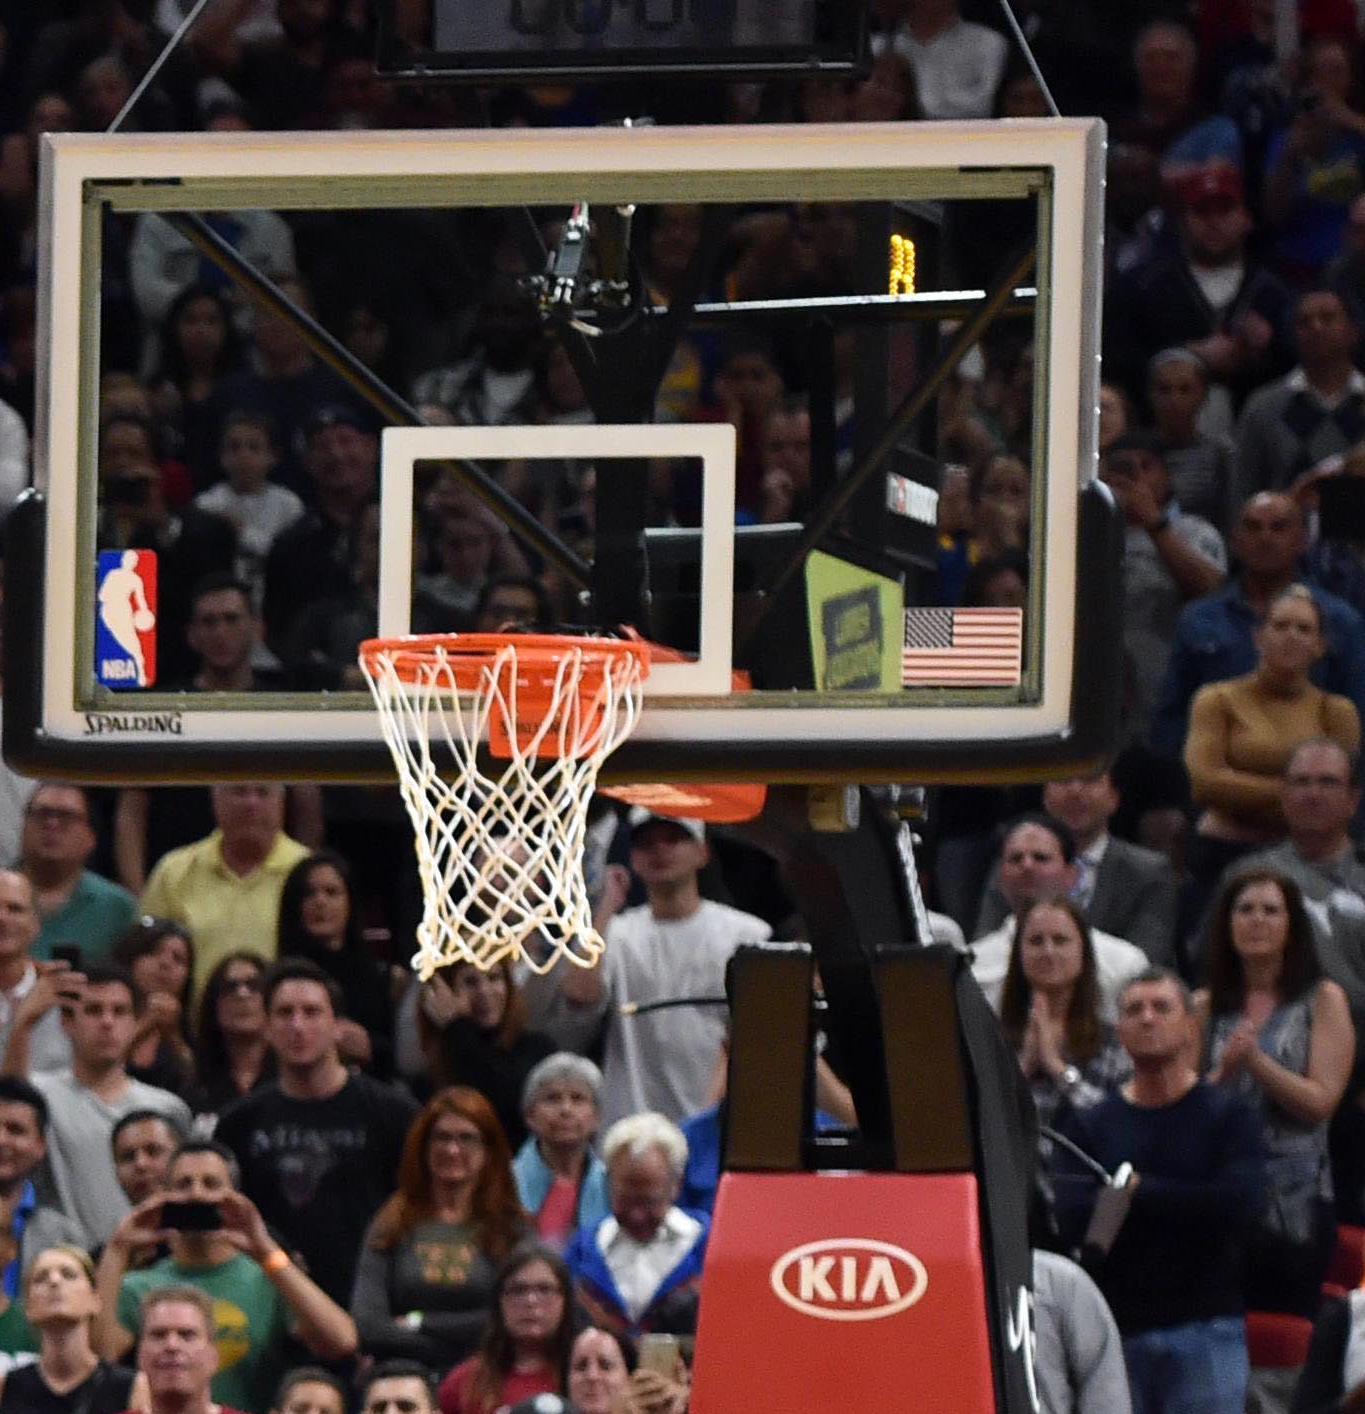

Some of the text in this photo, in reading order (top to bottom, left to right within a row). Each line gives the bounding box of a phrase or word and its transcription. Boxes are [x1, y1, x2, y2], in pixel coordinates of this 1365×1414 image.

[102, 658, 136, 680] NBA
[83, 712, 183, 736] SPALDING
[800, 1258, 902, 1305] KIA
